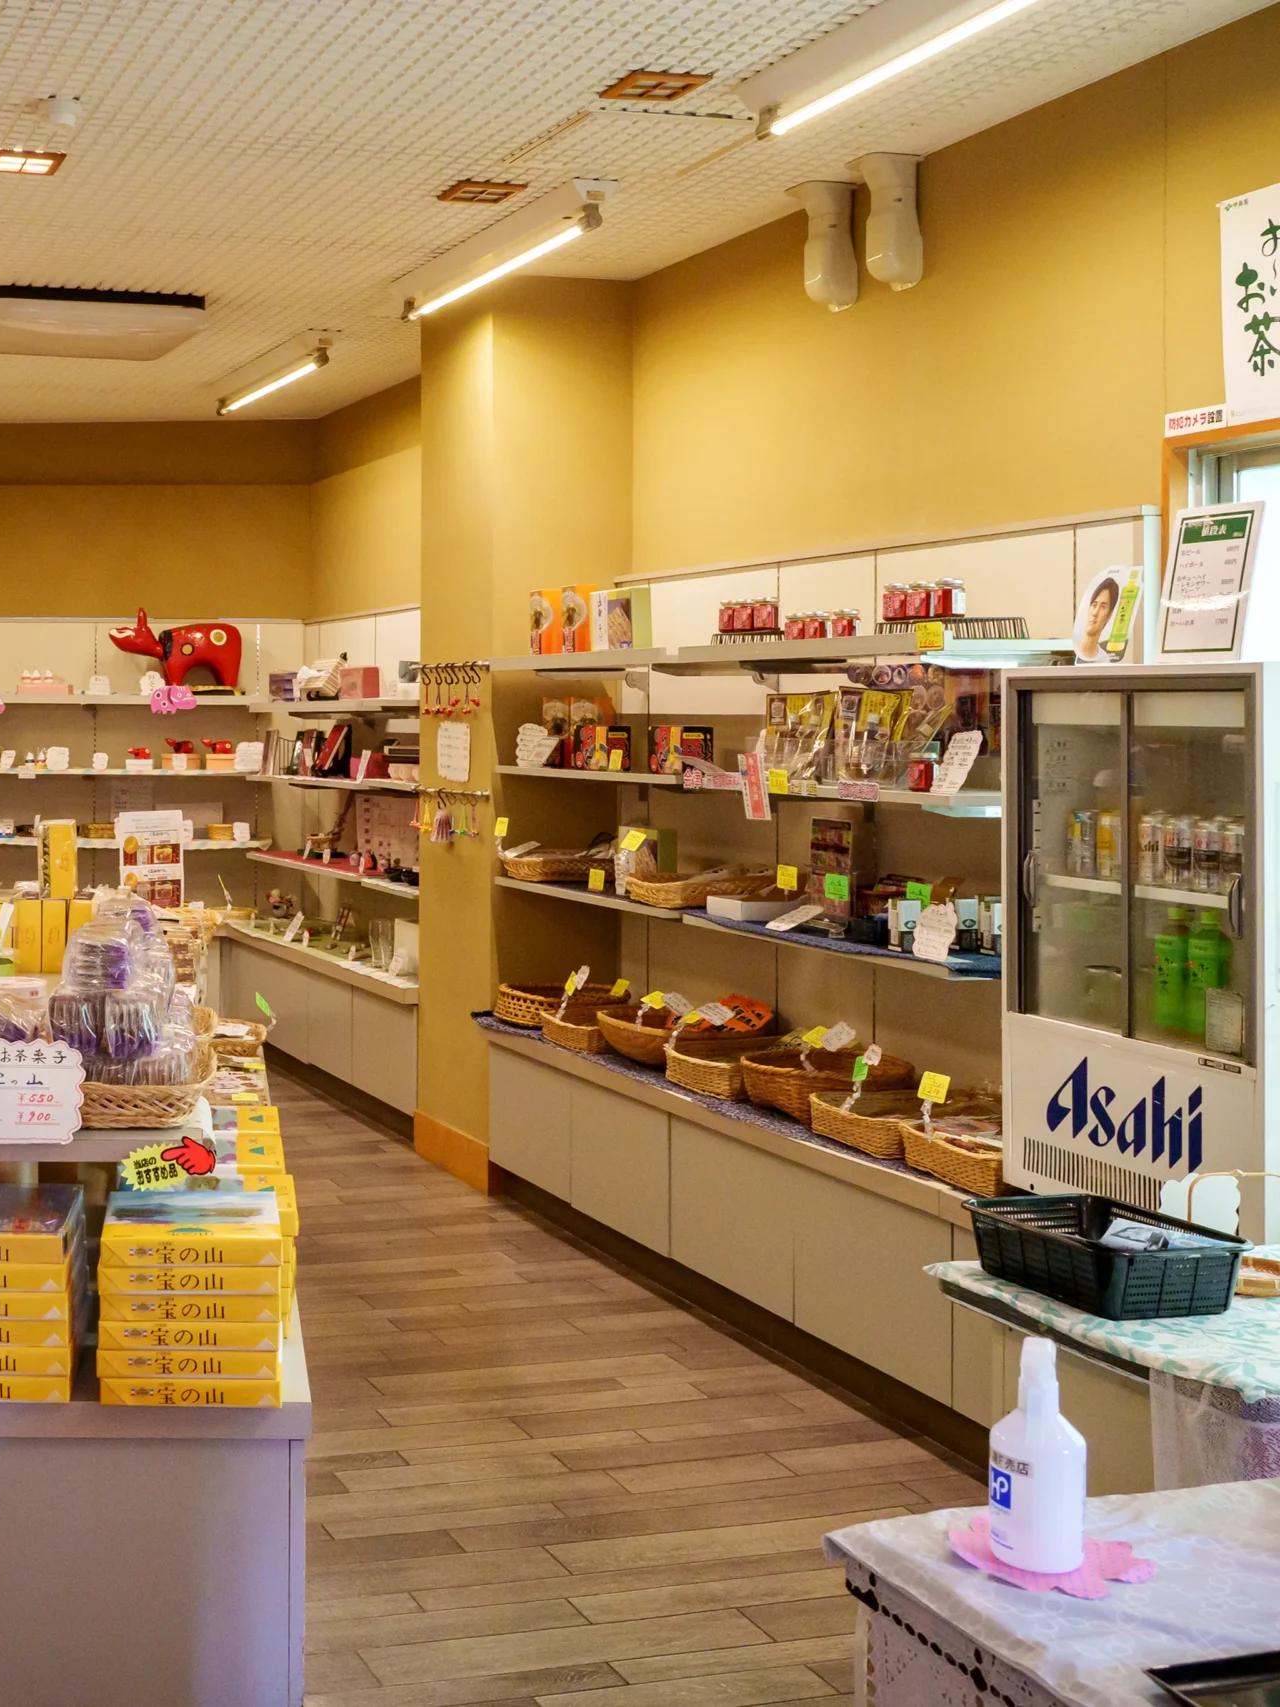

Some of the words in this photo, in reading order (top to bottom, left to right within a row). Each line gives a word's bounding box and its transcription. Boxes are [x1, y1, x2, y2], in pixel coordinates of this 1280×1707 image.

[1168, 409, 1223, 430] 防犯カメラ設置
[1046, 1056, 1203, 1173] Asahi
[133, 1156, 157, 1169] 当店の
[135, 1162, 179, 1185] おすすめ品
[156, 1246, 223, 1264] 宝の山
[156, 1272, 224, 1291] 宝の山
[158, 1301, 225, 1320] 宝の山
[150, 1327, 217, 1347] 宝の山
[154, 1355, 222, 1375] 宝の山
[157, 1386, 224, 1405] 宝の山
